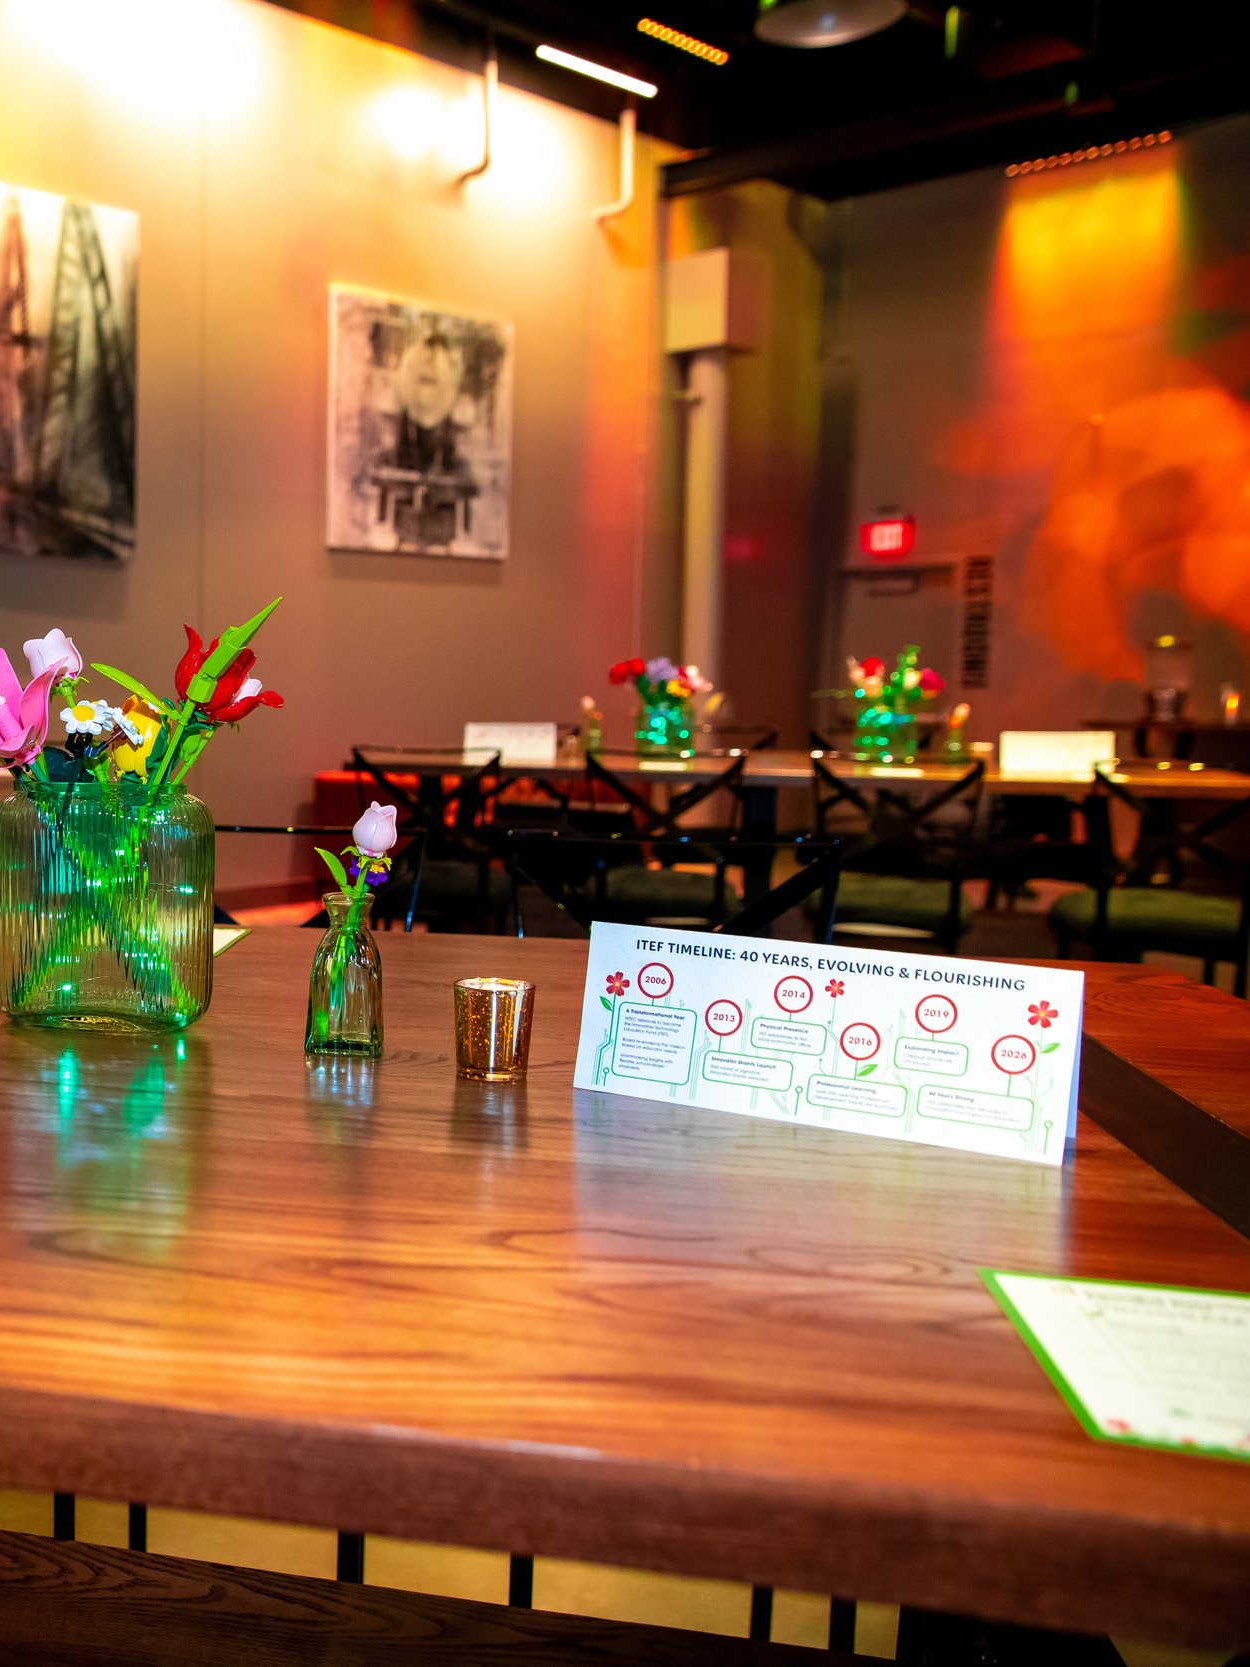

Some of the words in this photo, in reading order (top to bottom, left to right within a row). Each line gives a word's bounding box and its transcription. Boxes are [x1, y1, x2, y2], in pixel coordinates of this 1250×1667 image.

[636, 939, 665, 952] ITEF
[667, 942, 736, 960] TIMELINE:
[739, 950, 759, 962] 40
[763, 952, 813, 970] YEARS,
[817, 958, 895, 977] EVOLVING
[899, 967, 910, 979] &
[914, 969, 1025, 991] FLOURISHING
[645, 976, 667, 985] 2006
[782, 989, 806, 999] 2014
[713, 1013, 736, 1022] 2013
[924, 1008, 950, 1019] 2019
[759, 1022, 782, 1031] Physical
[783, 1026, 809, 1034] Presence
[848, 1036, 872, 1047] 2016
[1001, 1049, 1027, 1060] 2026
